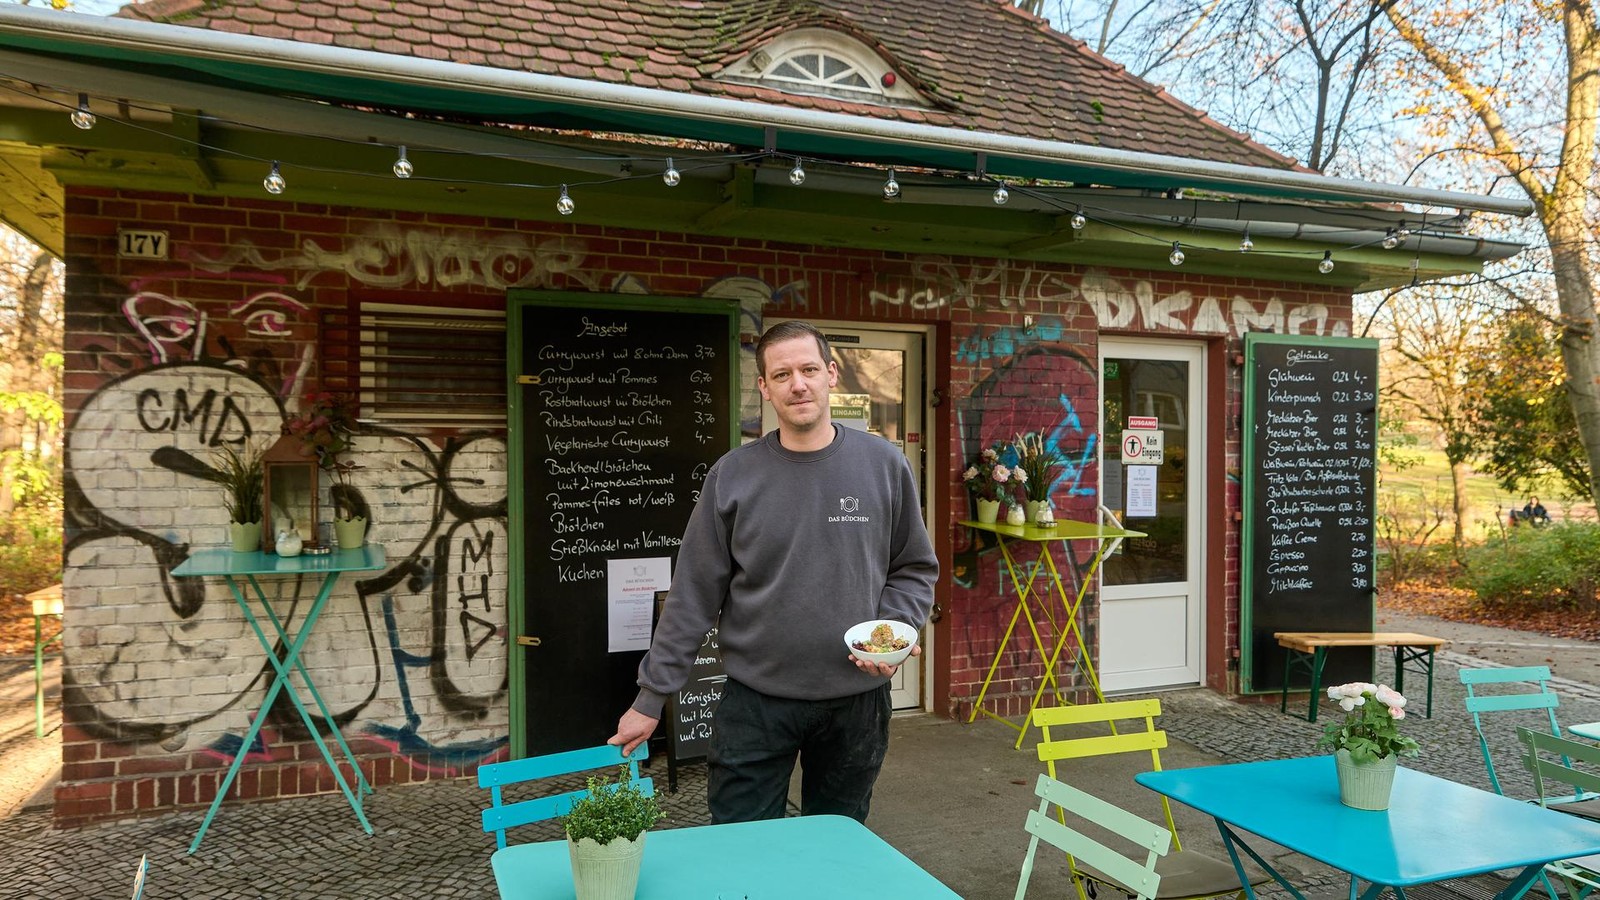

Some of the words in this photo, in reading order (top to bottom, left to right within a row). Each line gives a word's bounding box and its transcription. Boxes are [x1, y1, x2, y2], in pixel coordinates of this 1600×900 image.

[123, 234, 162, 256] 17Y
[576, 316, 628, 337] Angebot
[538, 345, 605, 371] Currywurst
[663, 346, 689, 360] Darm
[694, 344, 716, 361] 3,70
[1286, 348, 1330, 367] Getränke
[538, 368, 596, 394] Currywurst
[598, 371, 616, 384] mit
[616, 367, 658, 384] Pommes
[690, 370, 713, 384] 6,70
[1268, 368, 1316, 388] Glühwein
[539, 390, 611, 408] Rostbratwurst
[628, 391, 672, 407] Brötchen
[692, 390, 712, 406] 3,70
[1267, 388, 1321, 406] Kinderpunsch
[539, 411, 617, 428] Rindsbratwurst
[618, 416, 636, 427] mit
[637, 411, 663, 426] Chili
[694, 411, 716, 426] 3,70
[545, 434, 610, 456] Vegetarische
[611, 430, 670, 453] Currywurst
[1146, 435, 1158, 446] Kein
[1142, 446, 1161, 460] Eingang
[544, 458, 651, 476] Backhendlbrötchen
[557, 478, 579, 491] mit
[580, 473, 675, 491] Limonenschmand
[690, 490, 701, 503] 3
[550, 511, 605, 534] Brötchen
[841, 514, 870, 522] BÜDCHEN
[623, 537, 641, 550] mit
[1271, 533, 1293, 547] Kaffee
[1269, 548, 1306, 563] Espresso
[558, 564, 605, 583] Kuchen
[680, 711, 696, 723] mit
[699, 707, 714, 720] Ka
